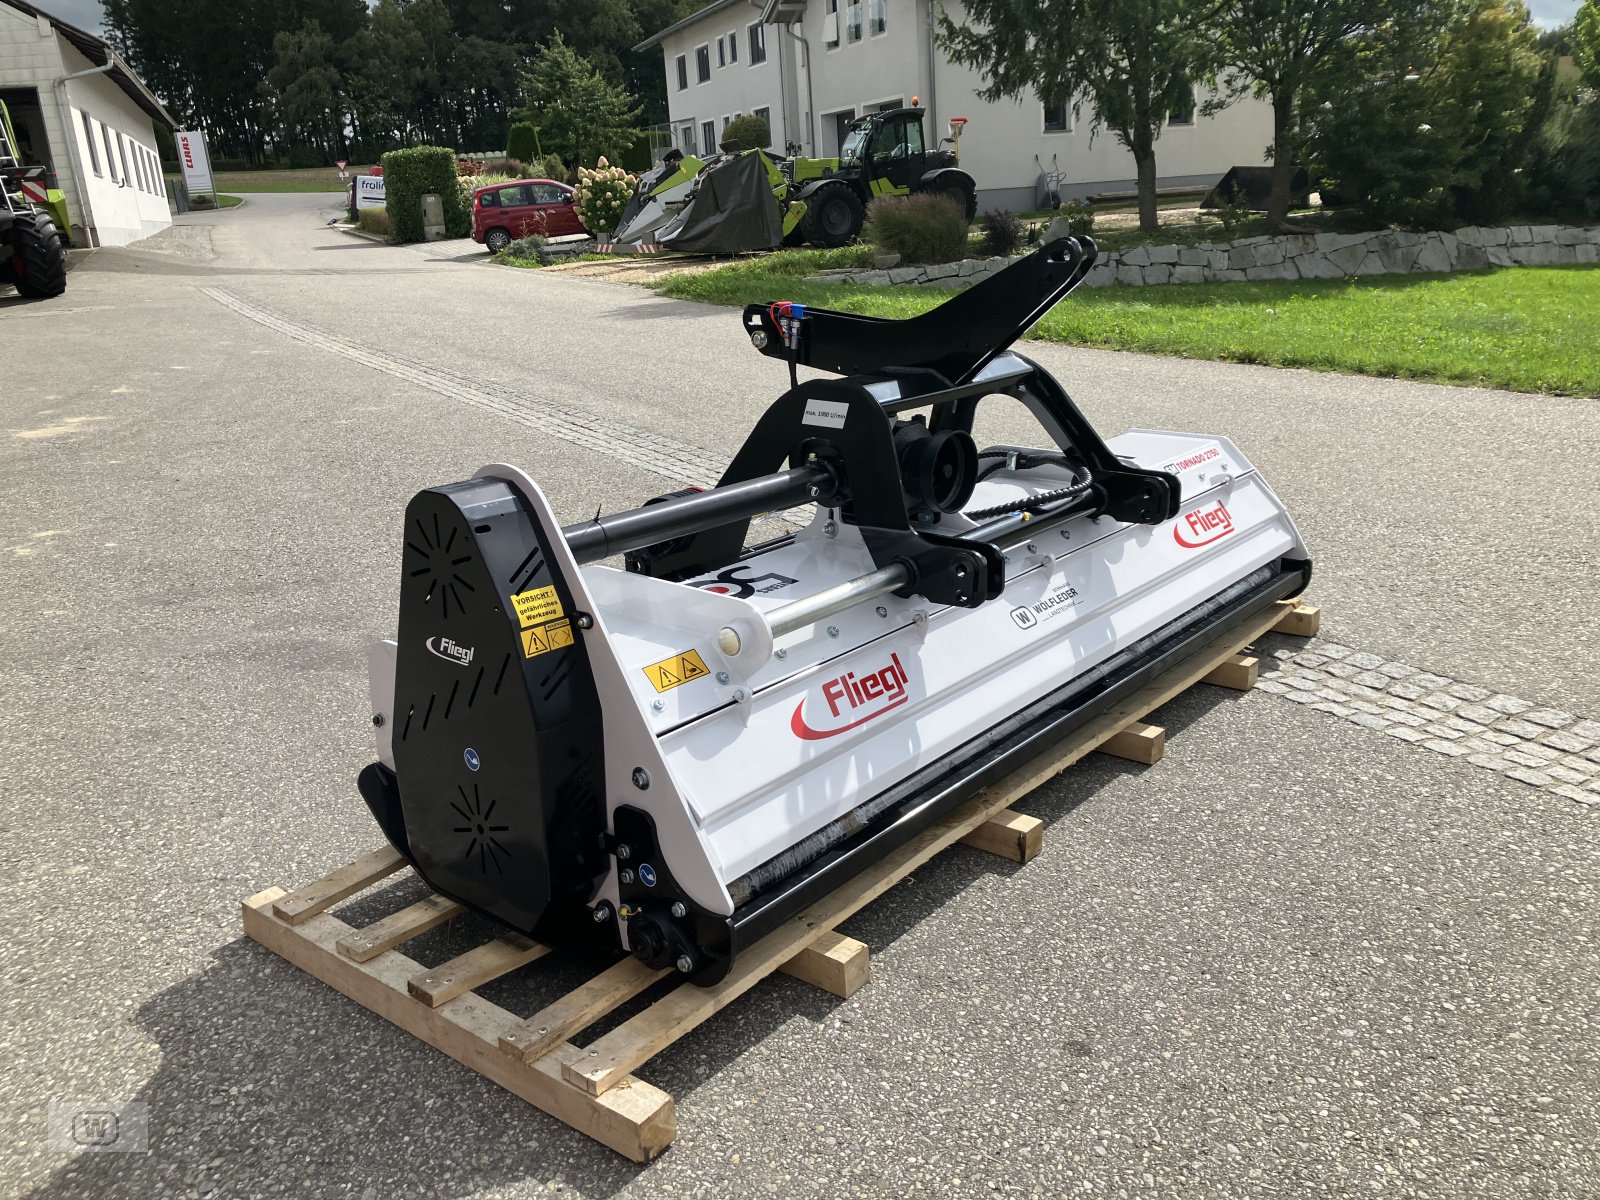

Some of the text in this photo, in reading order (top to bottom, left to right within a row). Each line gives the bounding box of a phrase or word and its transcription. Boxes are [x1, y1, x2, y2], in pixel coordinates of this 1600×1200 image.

[181, 136, 194, 168] CLAAS
[1176, 453, 1206, 471] TORNADO
[1203, 448, 1220, 460] 2750
[1184, 500, 1232, 537] Fliegl
[515, 591, 550, 606] VORSICHT
[519, 600, 559, 616] gefährliches
[525, 609, 557, 621] Werkzeug
[440, 637, 474, 663] Fliegl
[821, 652, 909, 717] Fliegl
